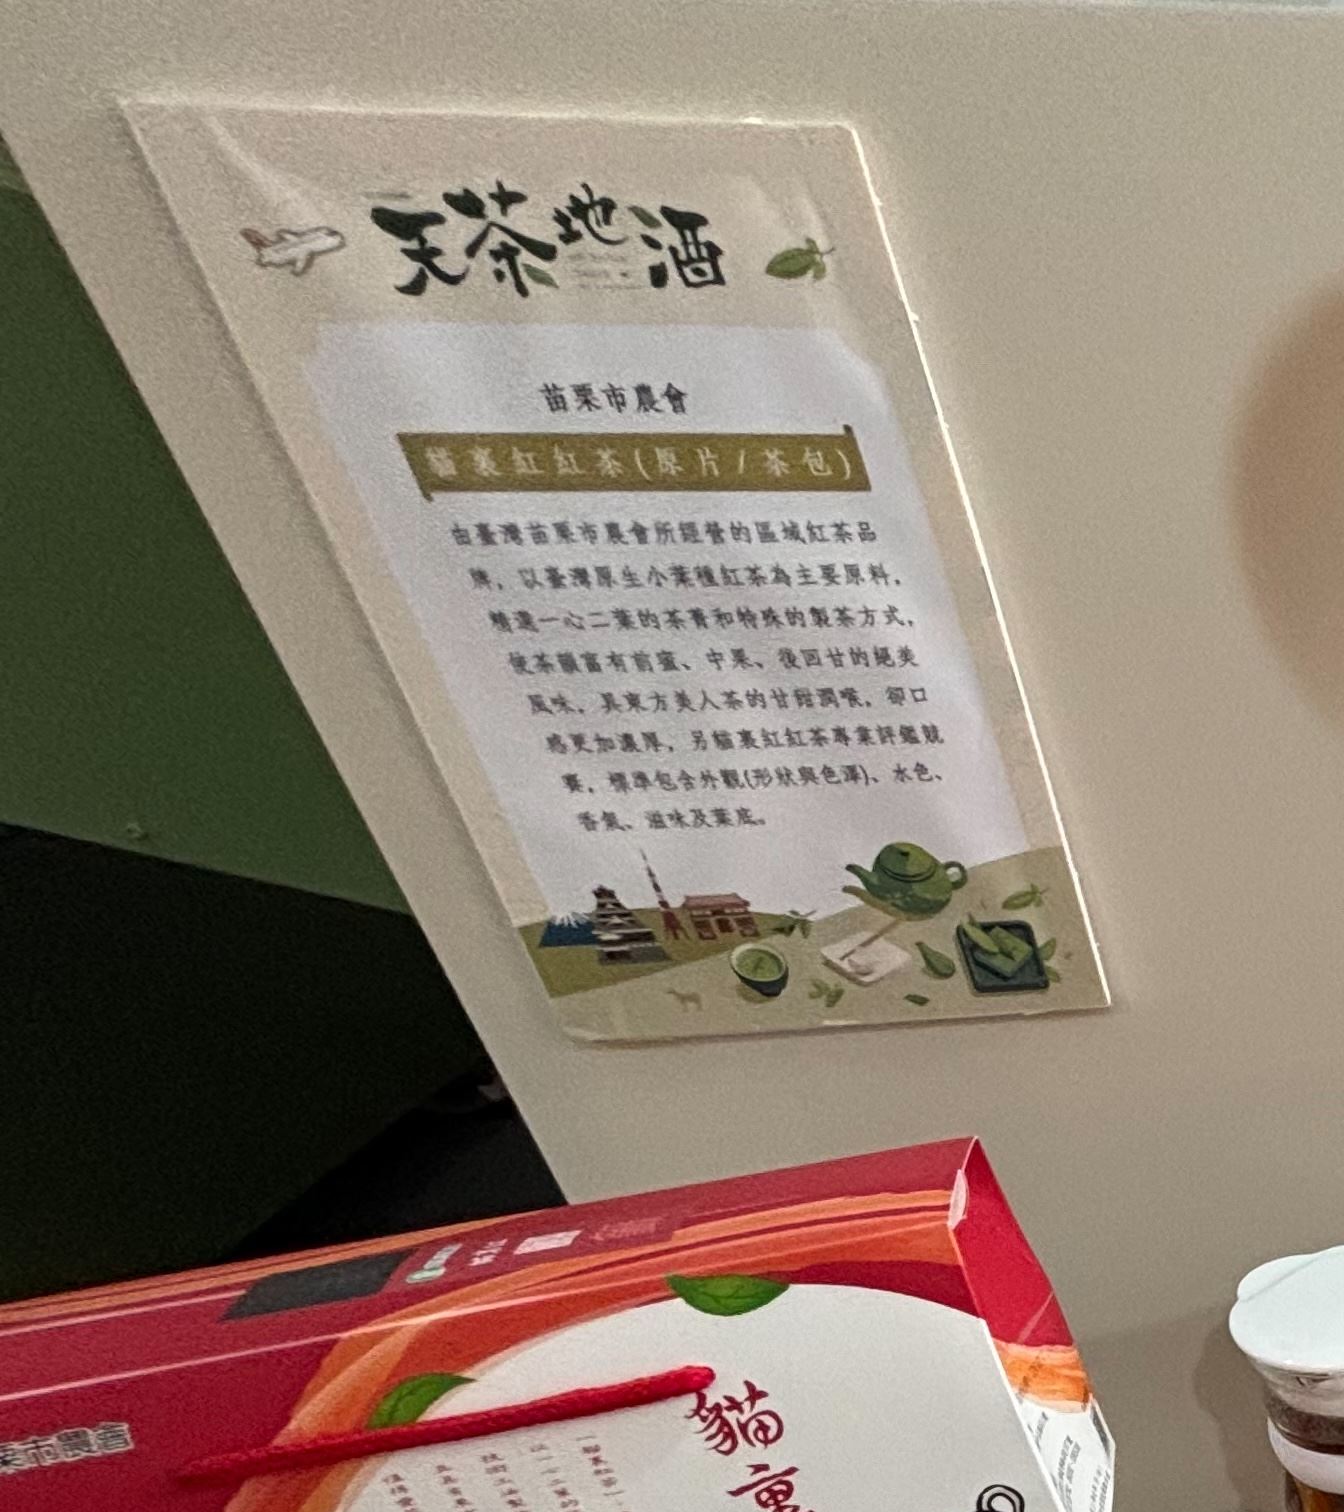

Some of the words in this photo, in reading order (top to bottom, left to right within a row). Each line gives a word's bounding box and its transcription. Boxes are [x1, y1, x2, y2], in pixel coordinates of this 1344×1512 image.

[371, 180, 727, 298] 天茶地酒
[540, 382, 689, 415] 苗栗市農會
